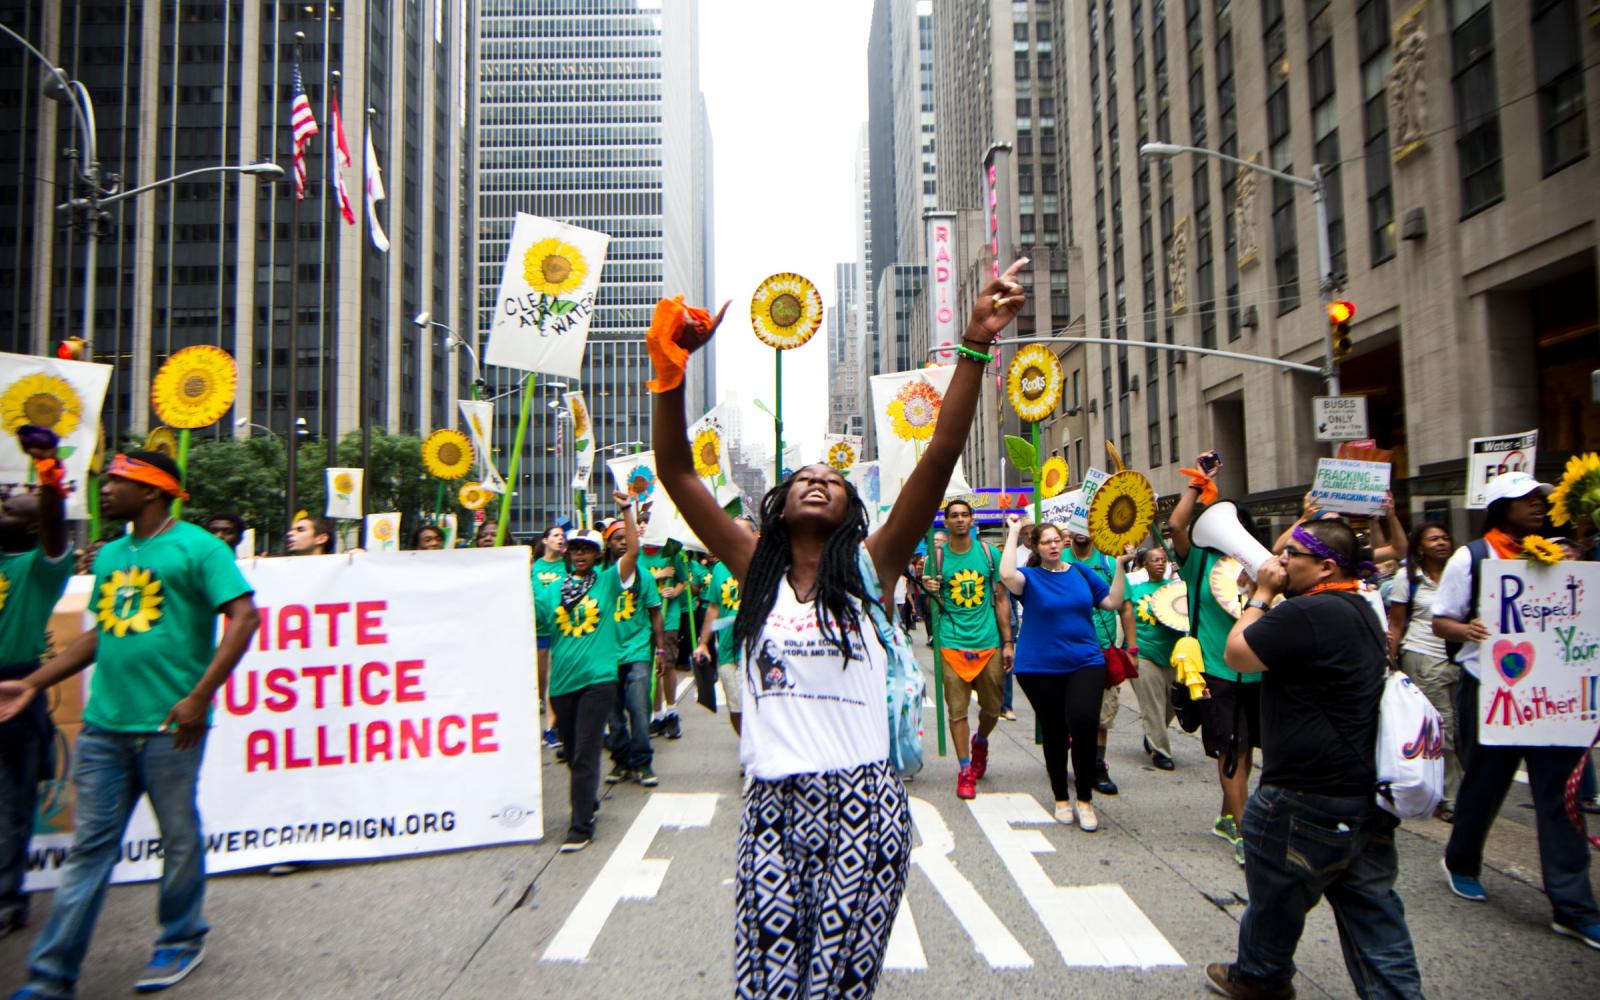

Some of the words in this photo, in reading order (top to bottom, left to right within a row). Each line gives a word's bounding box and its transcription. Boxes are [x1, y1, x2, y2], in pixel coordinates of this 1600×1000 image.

[935, 226, 953, 324] RADIO
[1323, 399, 1356, 409] BUSES
[1328, 414, 1354, 424] ONLY
[1483, 440, 1514, 451] Water
[1318, 468, 1371, 483] FRACKING
[1322, 480, 1357, 490] CLIMATE
[1311, 489, 1329, 498] BAN
[1331, 492, 1369, 502] FRACKING
[1499, 574, 1579, 634] Respect
[810, 648, 826, 656] AND
[828, 647, 840, 656] THE
[1554, 626, 1600, 662] Your
[214, 659, 426, 716] USTICE
[246, 712, 499, 773] ALLIANCE
[541, 793, 1187, 968] FRE
